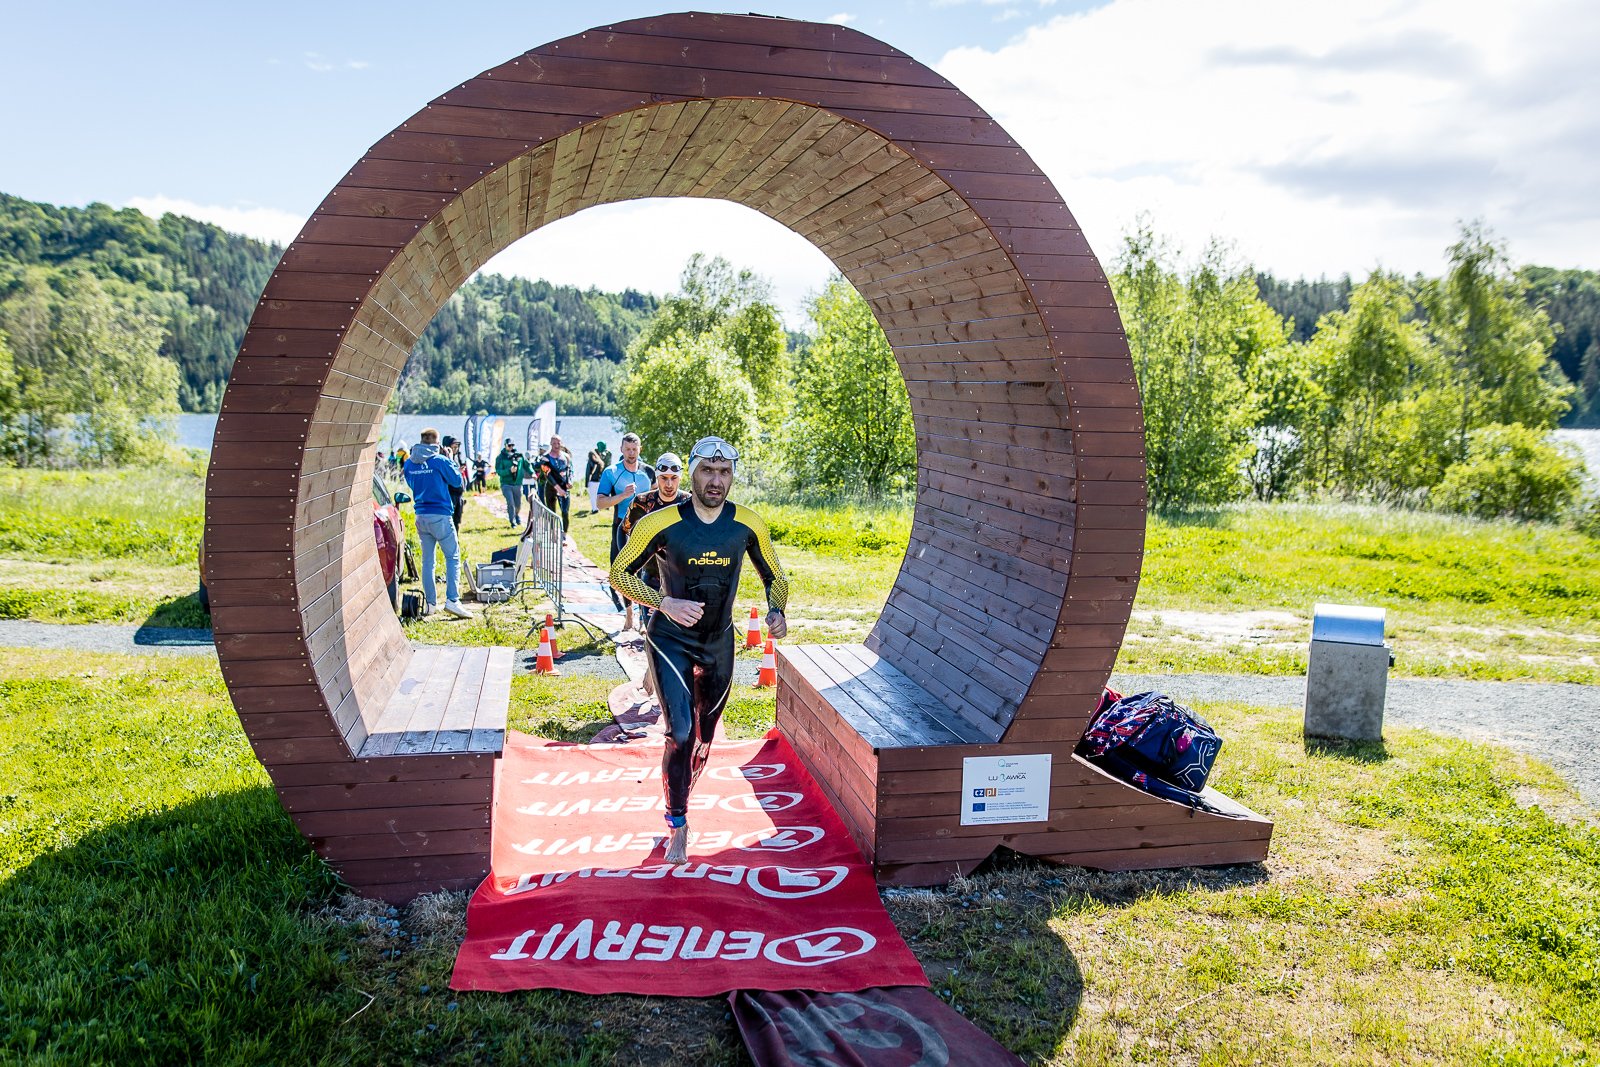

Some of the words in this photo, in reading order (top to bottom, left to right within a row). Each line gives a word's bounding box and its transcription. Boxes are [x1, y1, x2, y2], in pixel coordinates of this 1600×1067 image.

[688, 557, 731, 567] nabaiji
[523, 766, 662, 785] ERVIT
[490, 919, 766, 962] ENERVIT
